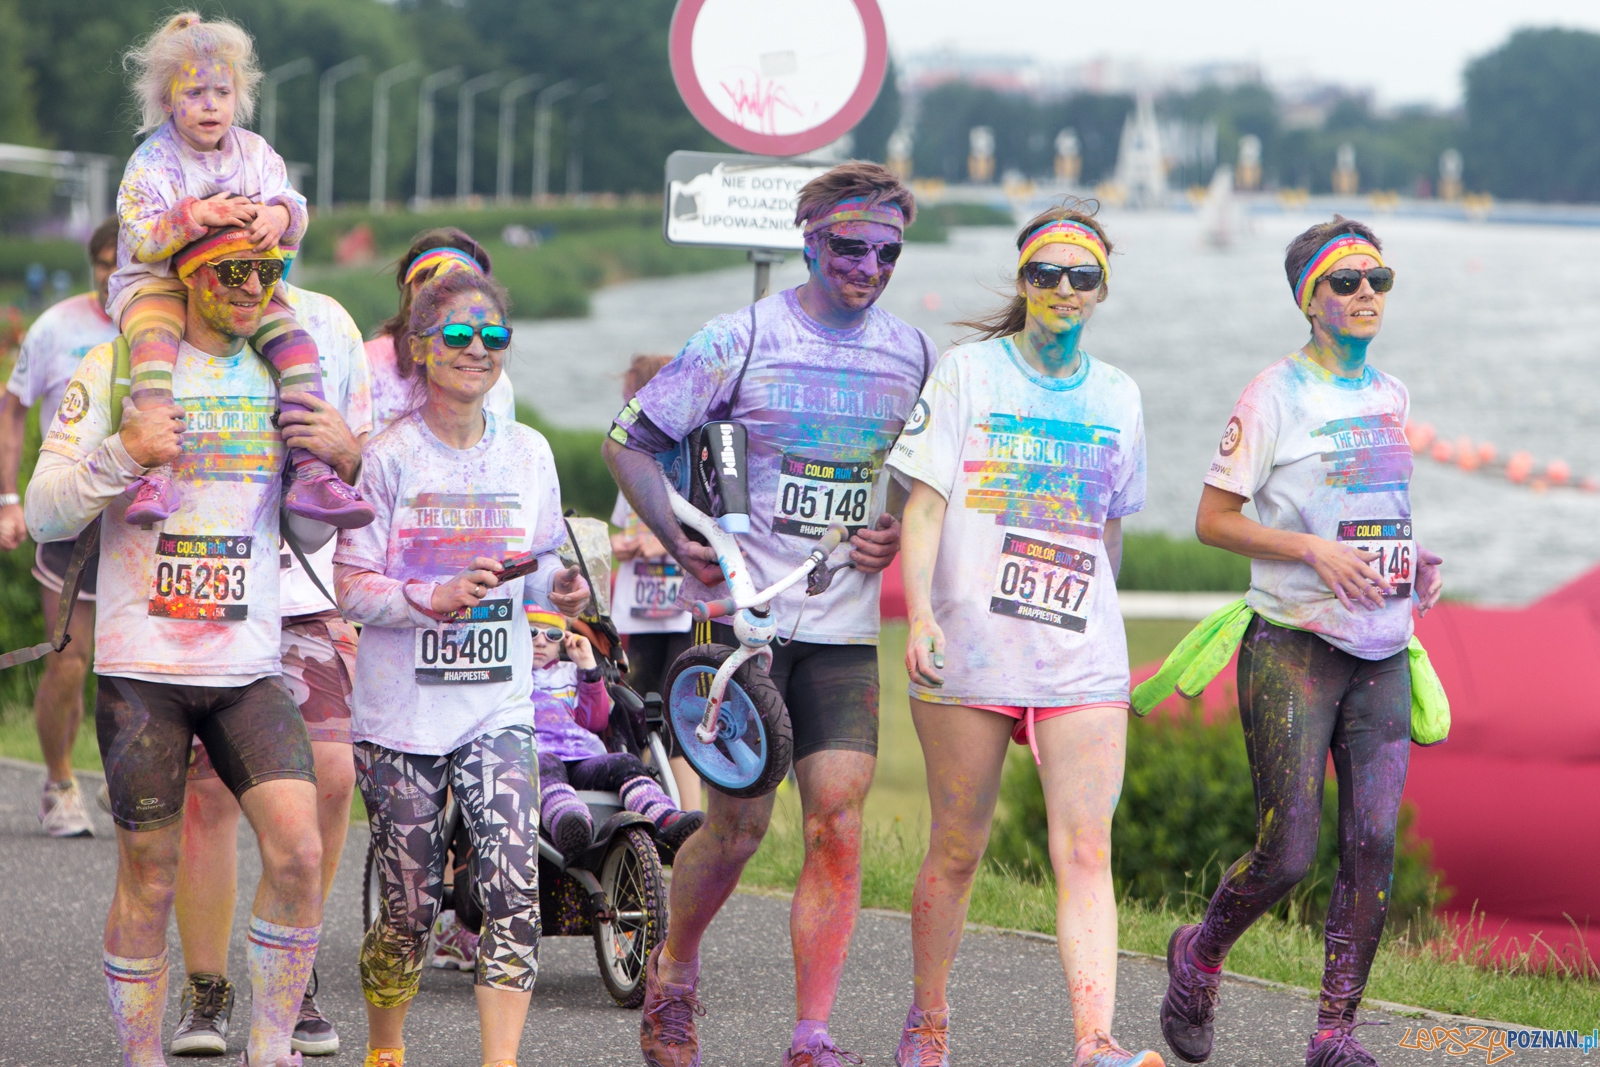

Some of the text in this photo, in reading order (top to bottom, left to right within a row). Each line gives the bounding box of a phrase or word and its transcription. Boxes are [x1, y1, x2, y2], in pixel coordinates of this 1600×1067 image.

[722, 176, 807, 192] NIE DOTYC
[701, 214, 805, 231] UPOWAŻNIO
[765, 383, 801, 410] THE
[197, 412, 240, 431] COLOR
[988, 433, 1019, 460] THE
[1022, 437, 1077, 465] COLOR
[1330, 431, 1354, 450] THE
[1353, 428, 1388, 448] COLOR
[789, 459, 852, 480] THE COLOR RUN
[781, 482, 868, 522] 05148
[415, 508, 440, 527] THE
[441, 508, 483, 528] COLOR
[1343, 525, 1397, 537] THE COLOR RUN
[161, 539, 177, 553] THE
[177, 541, 207, 555] COLOR
[1010, 539, 1073, 566] THE COLOR RUN
[156, 562, 246, 600] 05263
[1000, 561, 1089, 612] 05147
[635, 580, 677, 605] 0254
[1017, 604, 1063, 625] #HAPPIEST5K
[421, 627, 508, 665] 05480
[444, 670, 490, 681] #HAPPIEST5K
